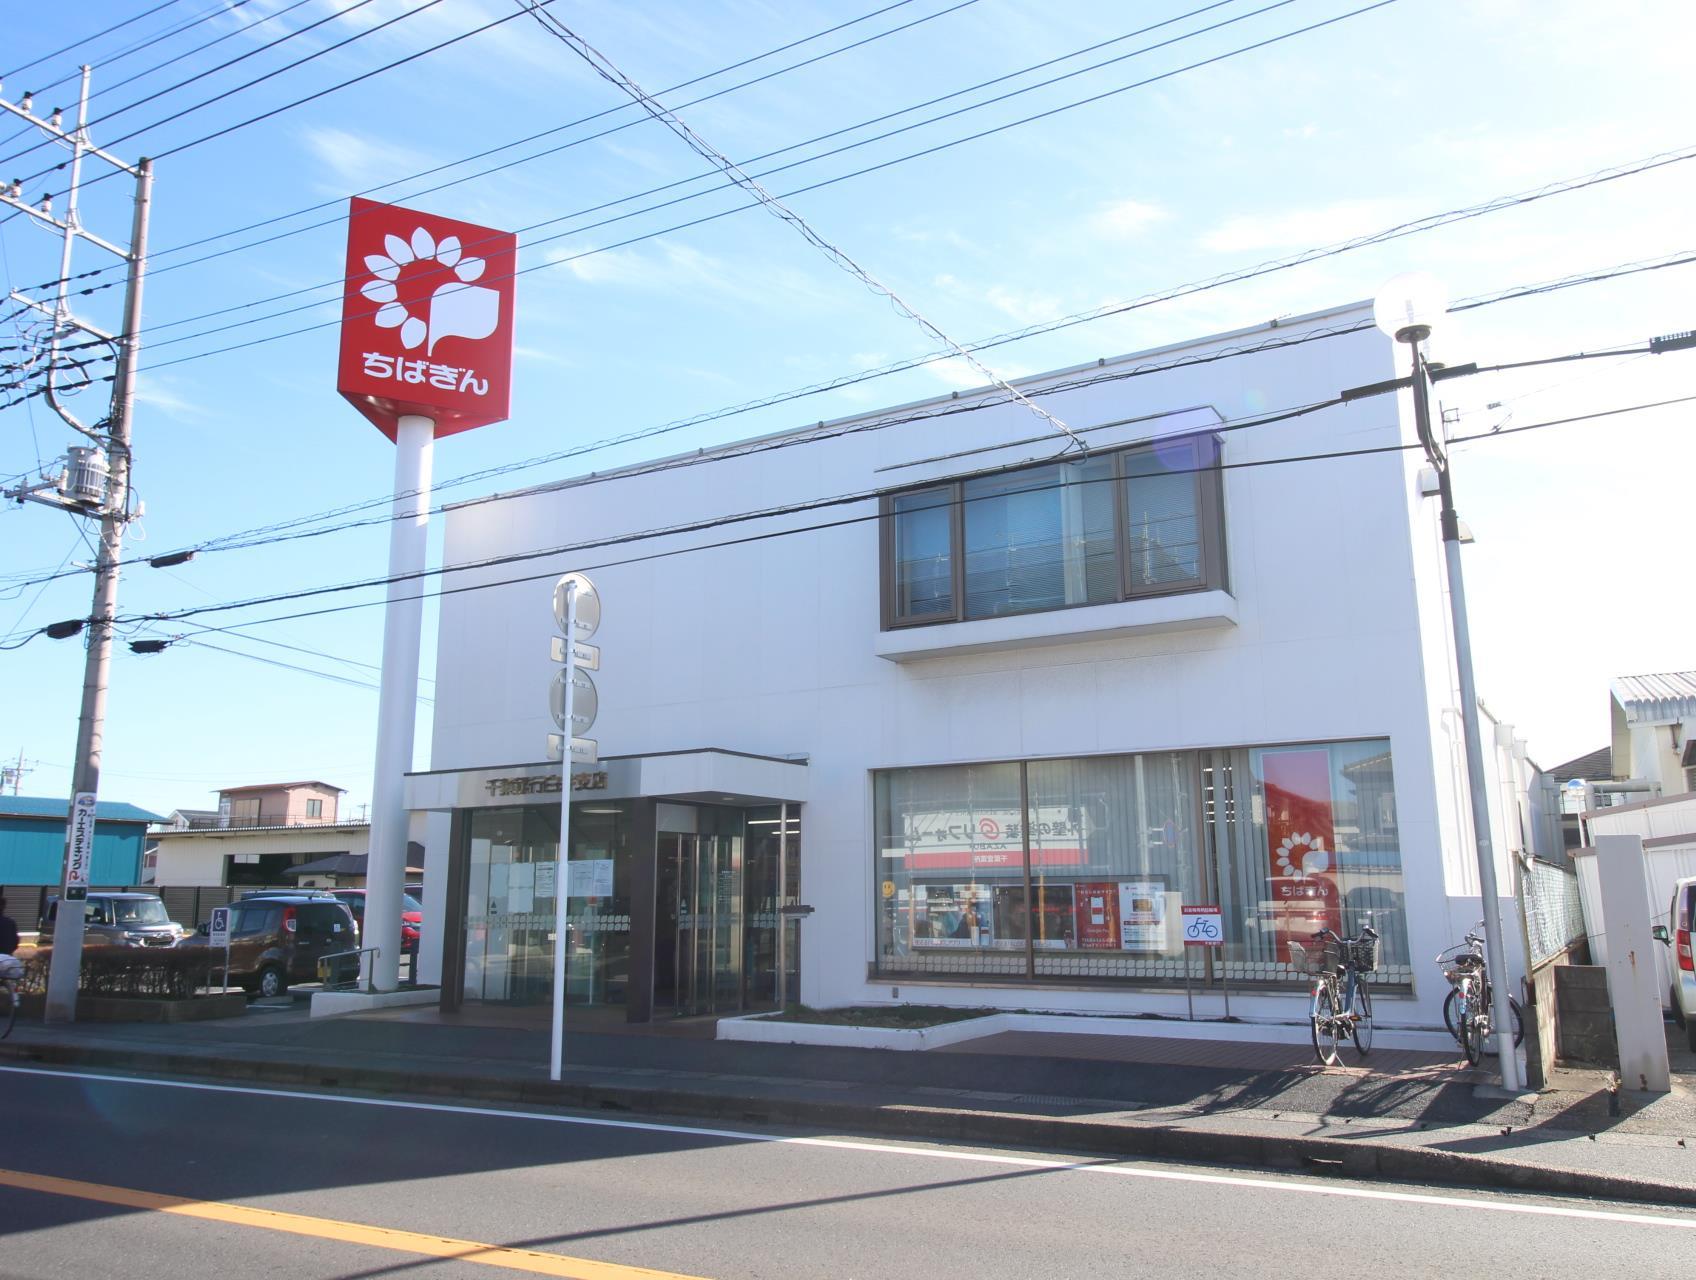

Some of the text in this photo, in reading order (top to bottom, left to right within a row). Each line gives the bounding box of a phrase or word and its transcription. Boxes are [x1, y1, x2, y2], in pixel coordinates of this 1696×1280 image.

[362, 352, 489, 396] ちばぎん
[485, 771, 608, 796] 千葉銀行白支店
